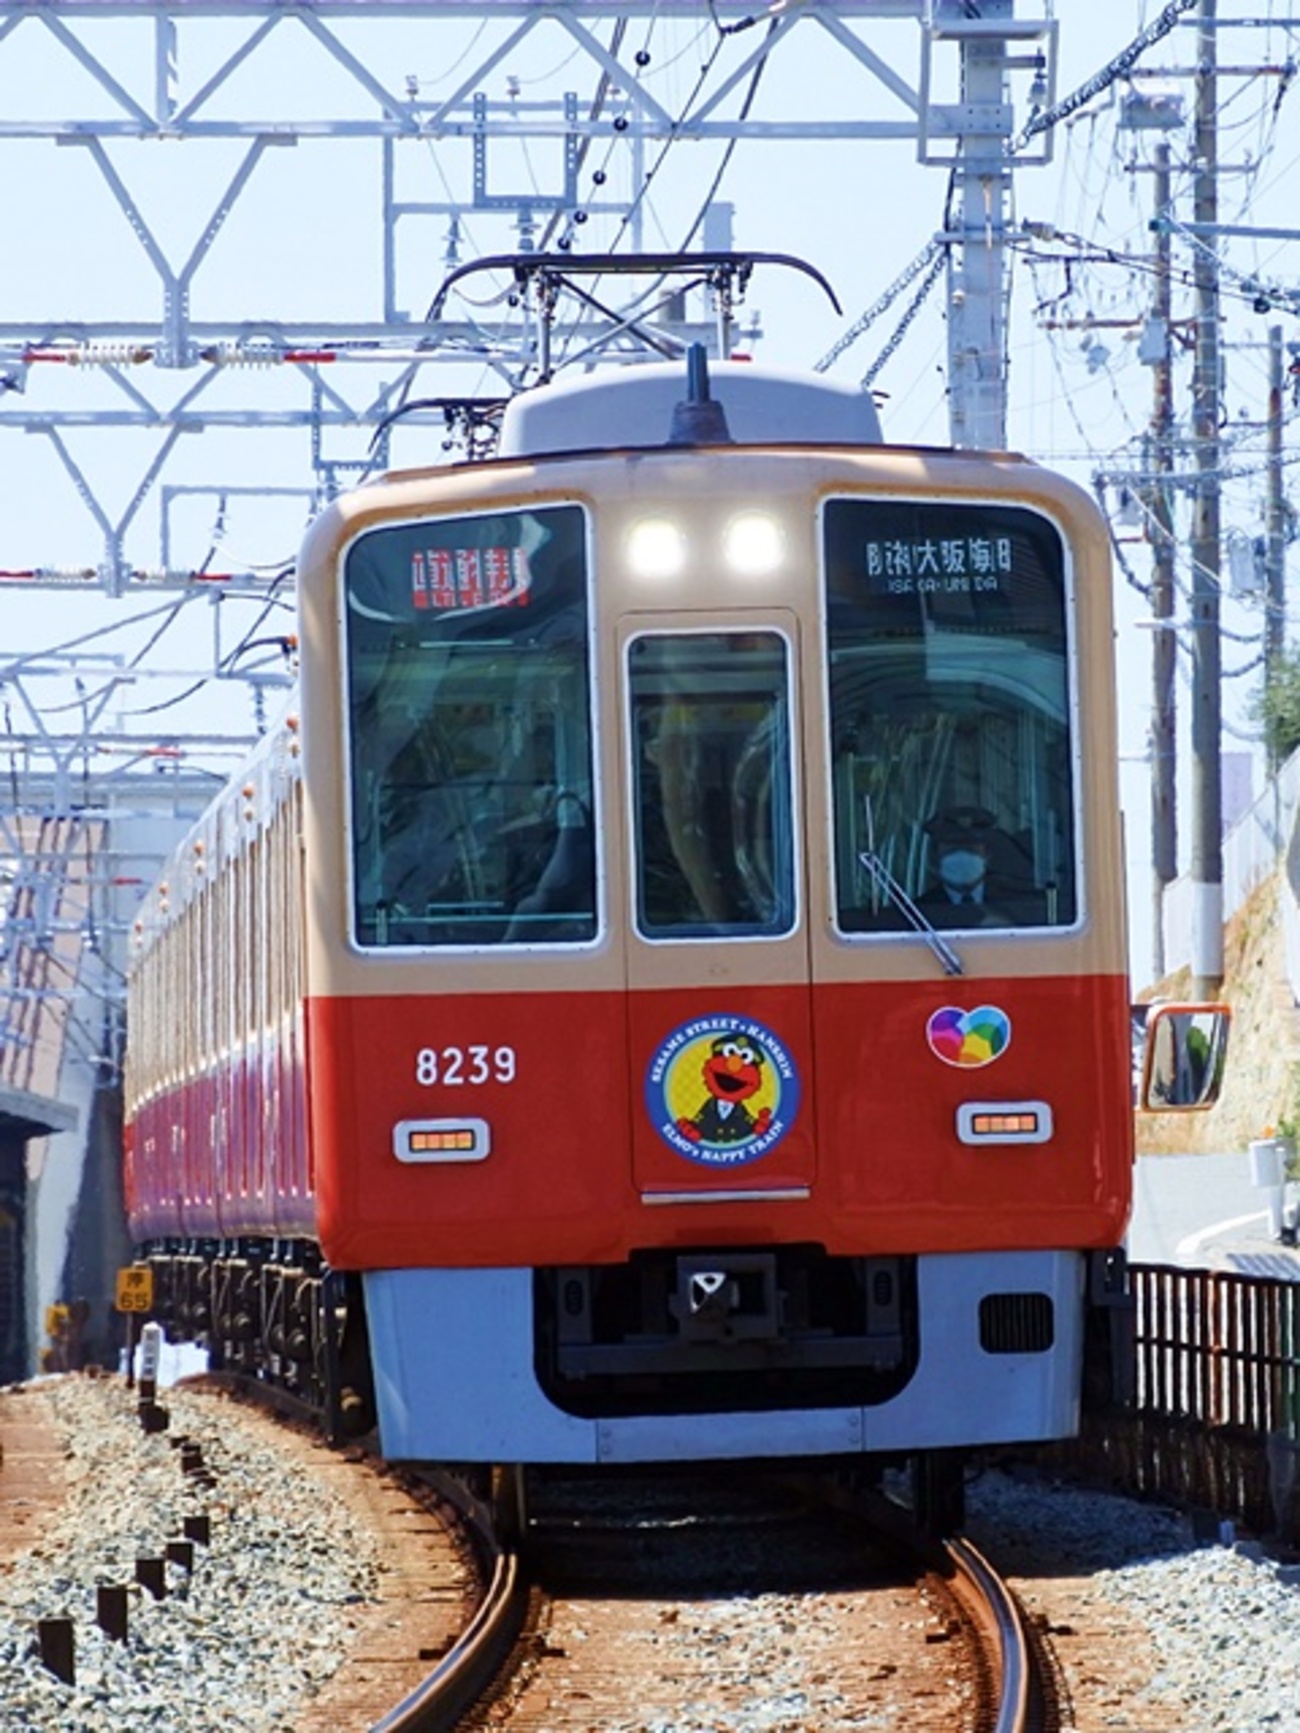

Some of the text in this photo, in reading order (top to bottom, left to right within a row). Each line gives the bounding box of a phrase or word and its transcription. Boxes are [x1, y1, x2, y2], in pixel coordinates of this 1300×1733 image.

[416, 1045, 517, 1086] 8239
[651, 1018, 794, 1083] SESAME STREET HANSHIN
[700, 1148, 746, 1162] HAPPY
[748, 1119, 784, 1155] TRAIN
[120, 1291, 149, 1309] 65
